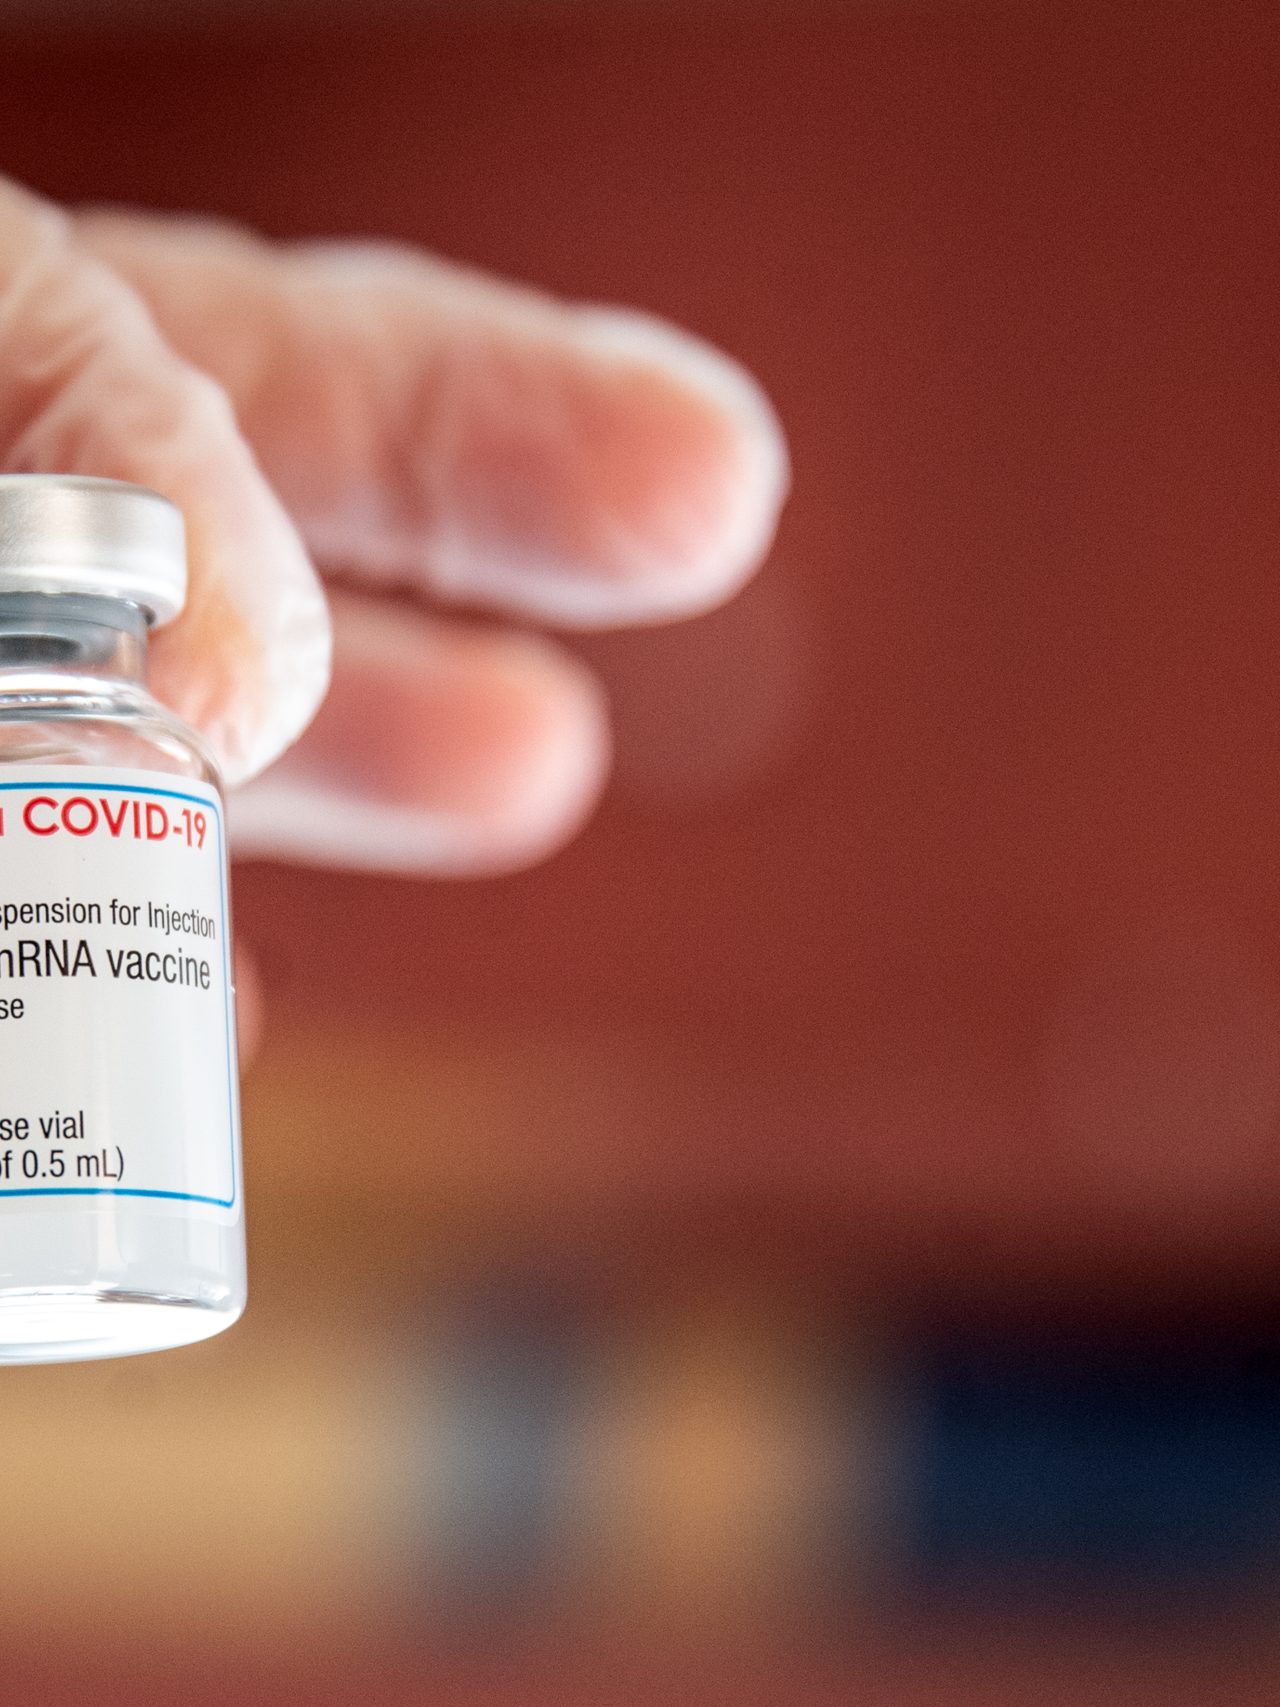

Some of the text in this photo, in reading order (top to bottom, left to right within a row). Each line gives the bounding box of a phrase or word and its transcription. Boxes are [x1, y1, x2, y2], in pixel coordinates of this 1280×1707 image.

[23, 796, 206, 849] COVID-19
[110, 900, 140, 926] for
[148, 902, 216, 940] Injection
[106, 948, 210, 989] vaccine
[39, 1111, 85, 1140] vial
[22, 1150, 65, 1178] 0.5
[76, 1146, 124, 1181] mL)
